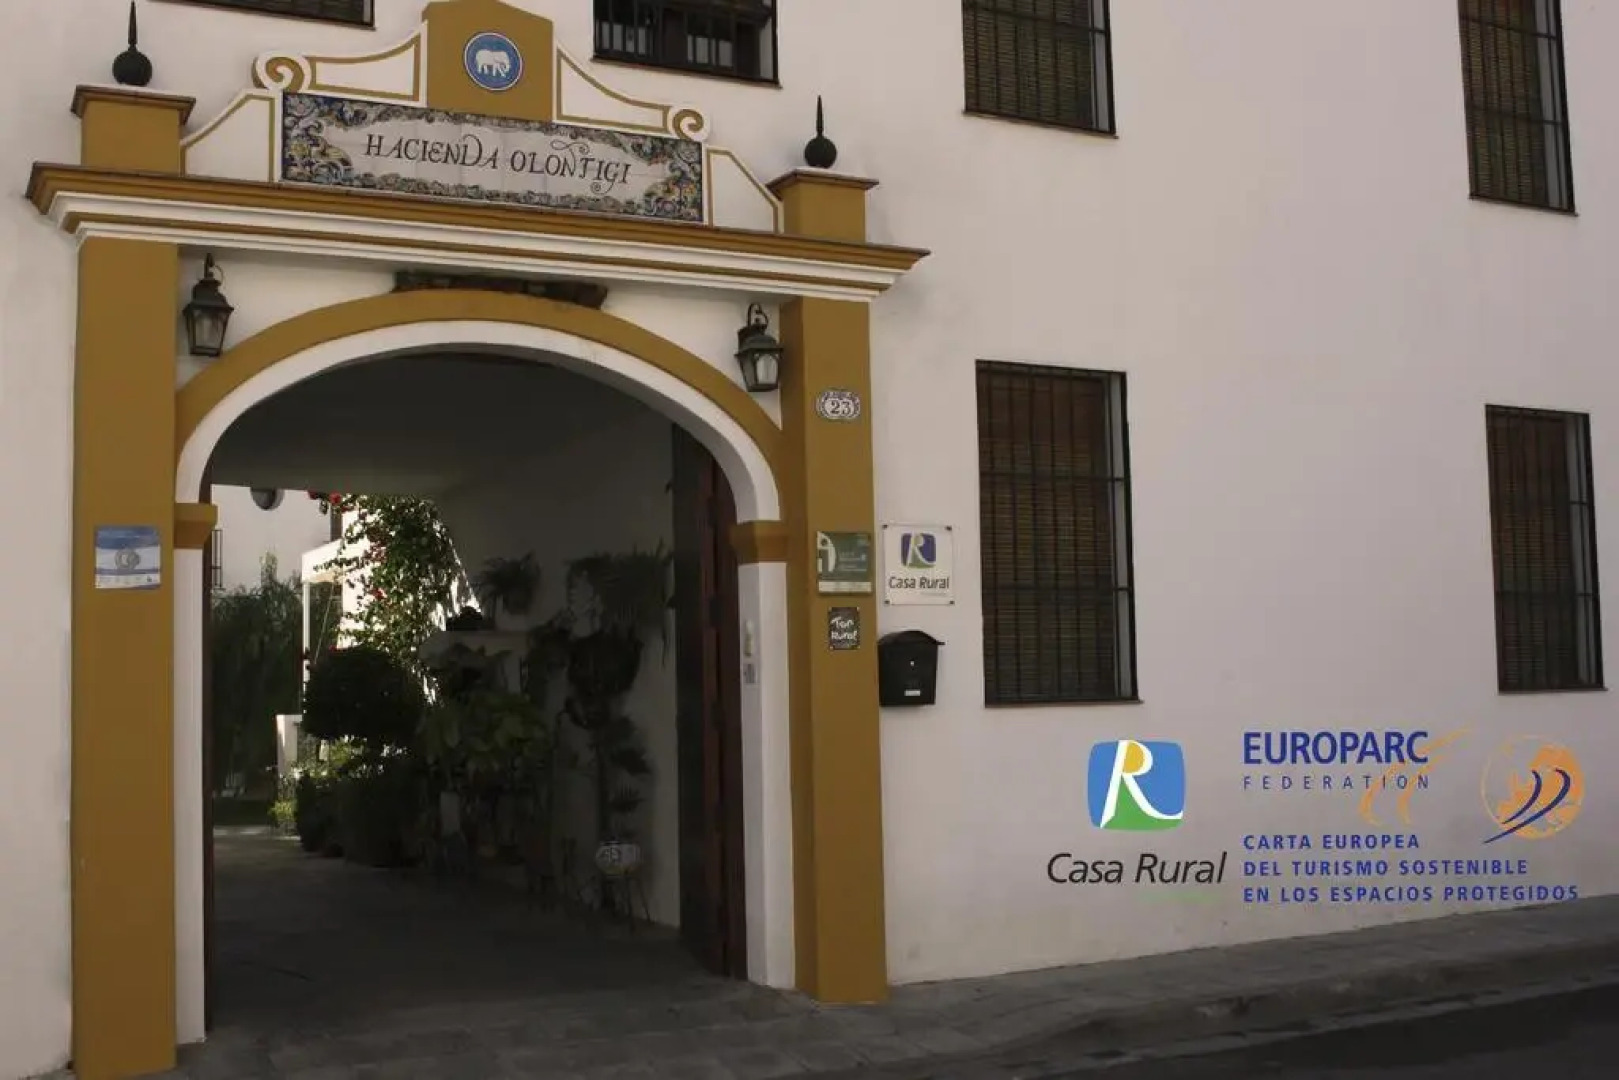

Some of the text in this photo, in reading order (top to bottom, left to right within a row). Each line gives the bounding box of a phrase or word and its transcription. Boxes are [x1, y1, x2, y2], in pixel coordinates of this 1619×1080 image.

[364, 133, 632, 194] HACIENDA OLONTIGI
[830, 399, 851, 415] 23
[888, 576, 950, 589] Casa Rural
